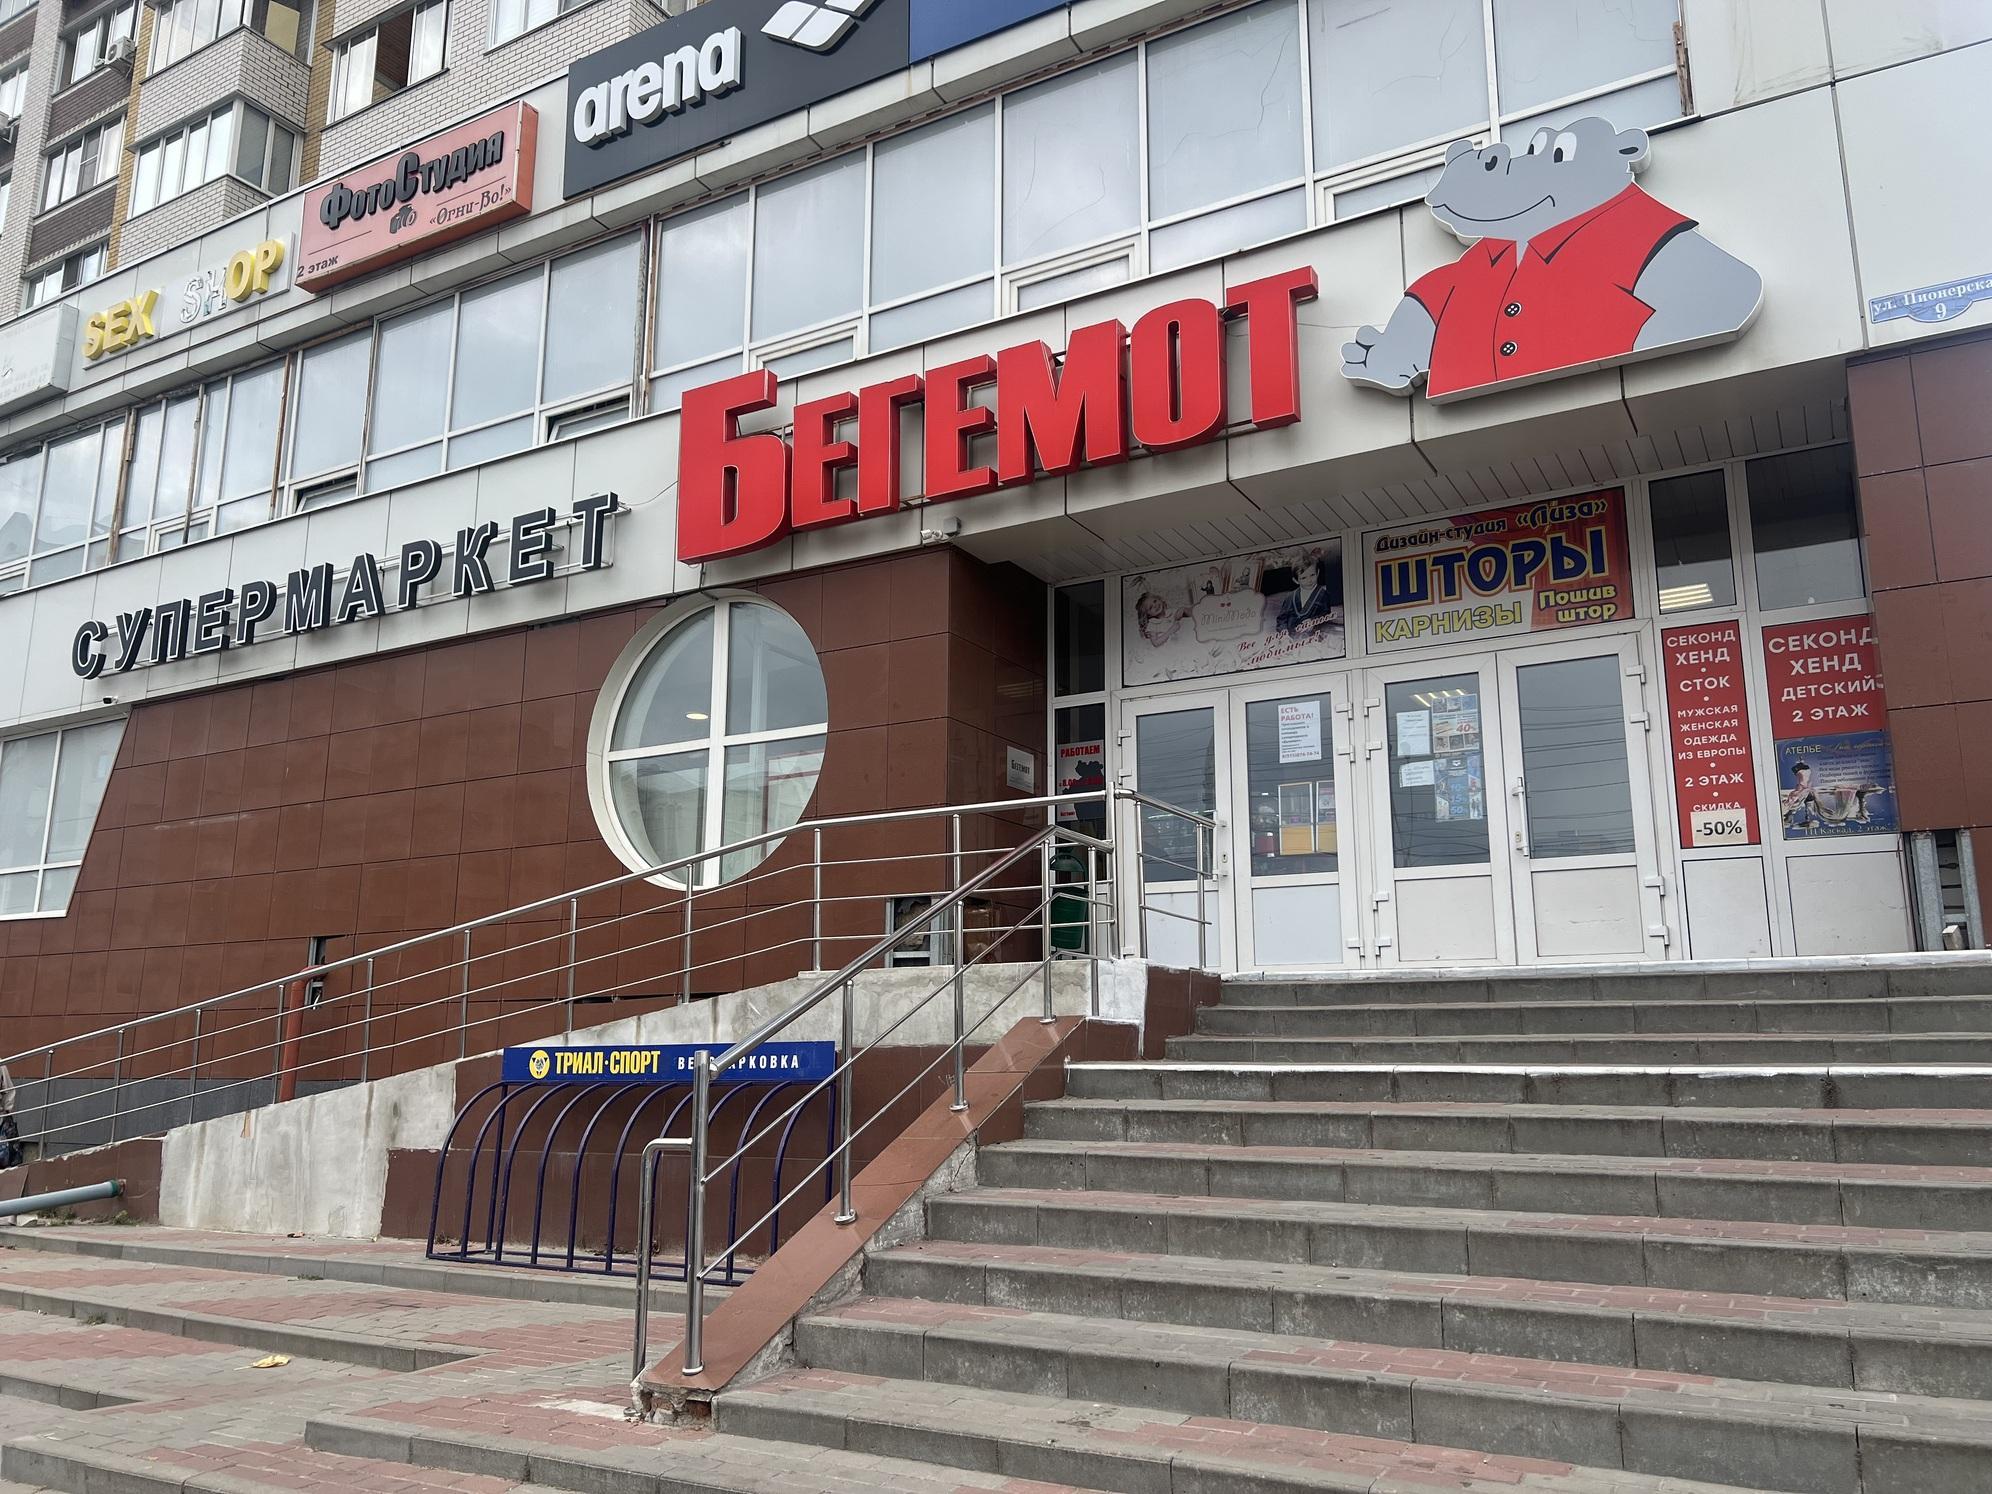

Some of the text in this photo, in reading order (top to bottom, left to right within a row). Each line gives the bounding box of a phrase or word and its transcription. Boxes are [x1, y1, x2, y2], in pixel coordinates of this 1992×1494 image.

[573, 26, 742, 144] arena
[297, 254, 339, 278] 2 этаж
[81, 239, 286, 361] SEX SHOP
[1873, 299, 1897, 316] ул.
[1934, 302, 1947, 319] 9
[677, 264, 1320, 565] БЕГЕМОТ
[1375, 499, 1608, 553] Дизайн-студия «Лиза»
[1375, 526, 1610, 613] ШТОРЫ
[71, 491, 619, 681] СУПЕРМАРКЕТ
[1538, 584, 1617, 611] Пошив
[1374, 601, 1523, 644] КАРНИЗЫ
[1555, 602, 1617, 624] штор
[1666, 629, 1736, 648] СЕКОНД
[1768, 627, 1876, 654] СЕКОНД
[1675, 647, 1731, 666] ХЕНД
[1789, 652, 1862, 676] ХЕНД
[1679, 675, 1731, 692] СТОК
[1781, 674, 1876, 702] ДЕТСКИЙ
[1280, 706, 1299, 714] ЕСТЬ
[1280, 713, 1314, 721] РАБОТА!
[1677, 704, 1739, 719] МУЖСКАЯ
[1792, 703, 1869, 723] 2 ЭТАЖ
[1680, 718, 1739, 733] ЖЕНСКАЯ
[1683, 733, 1737, 747] ОДЕЖДА
[1785, 744, 1822, 755] АТЕЛЬЕ
[1060, 744, 1101, 759] РАБОТАЕМ
[1678, 746, 1746, 761] ИЗ ЕВРОПЫ
[1684, 771, 1745, 788] 2 ЭТАЖ
[1692, 801, 1742, 813] СКИДКА
[1695, 819, 1743, 837] -50%
[677, 1054, 800, 1071] ВЕРКОВКА
